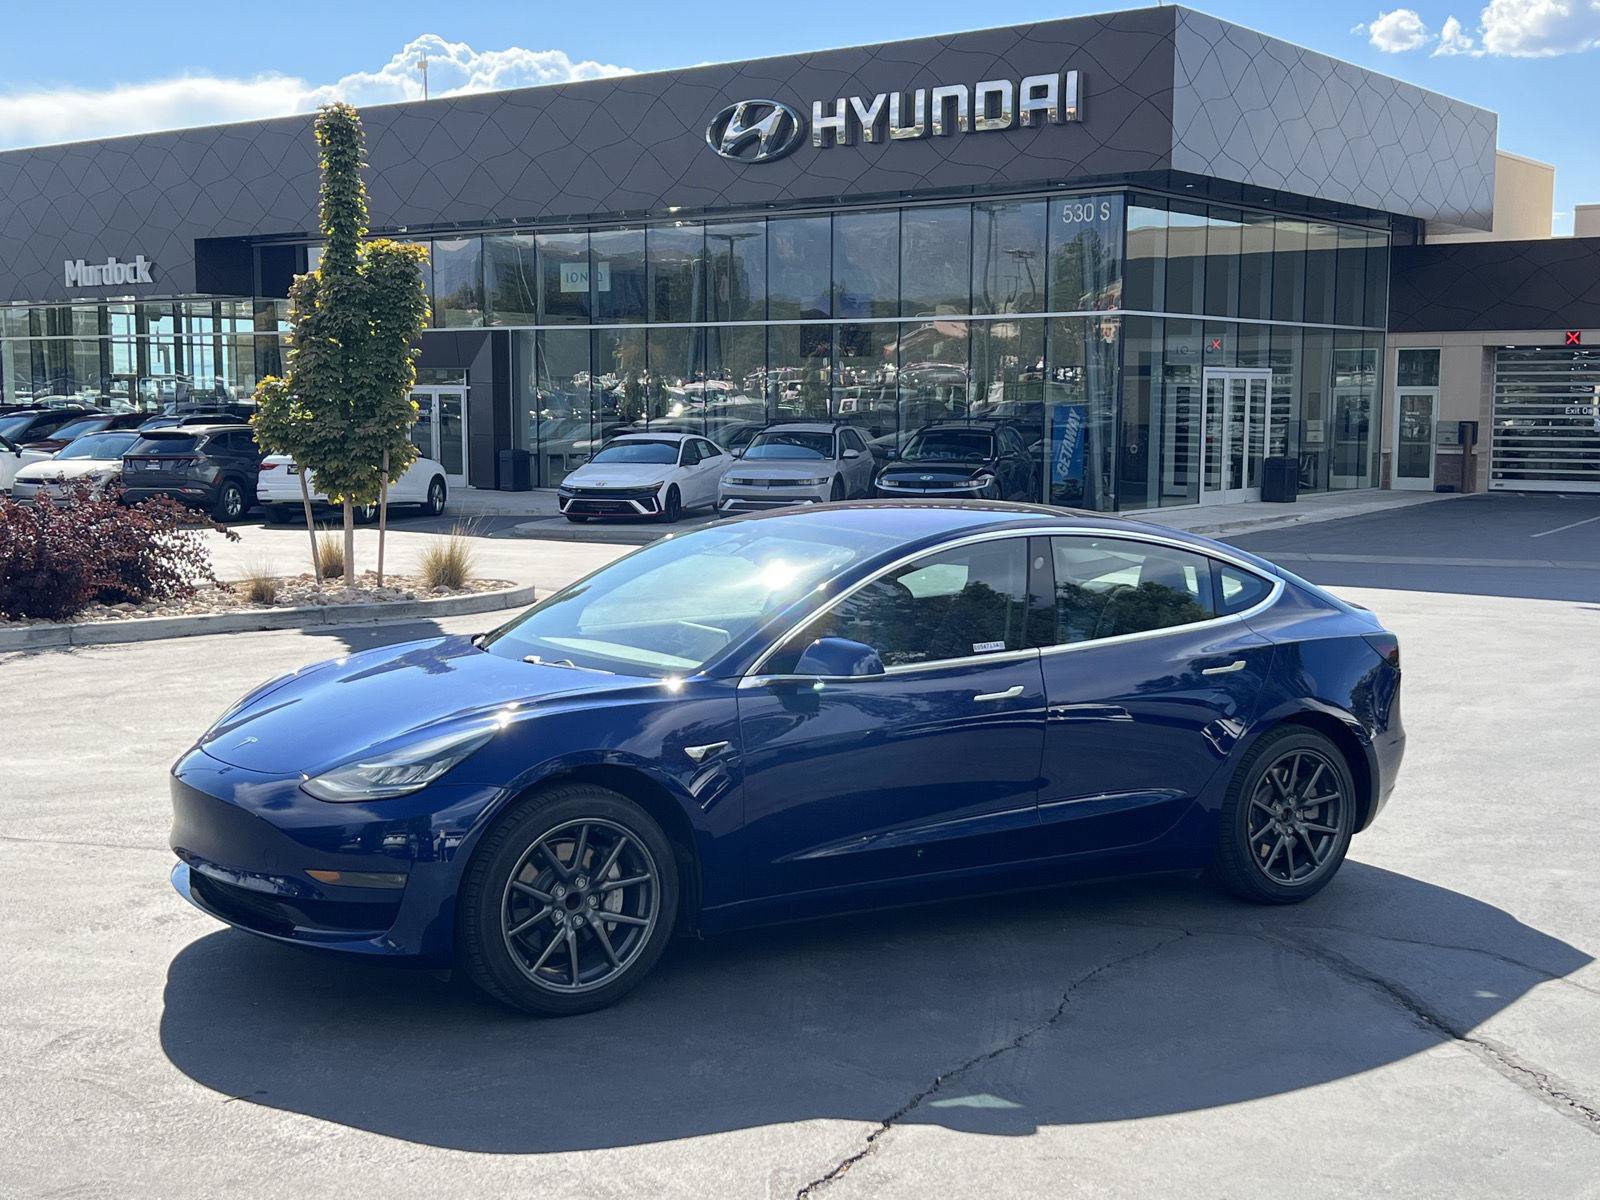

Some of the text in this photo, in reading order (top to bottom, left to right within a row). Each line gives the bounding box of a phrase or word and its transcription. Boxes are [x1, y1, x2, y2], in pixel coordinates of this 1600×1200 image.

[812, 70, 1083, 148] HYUNDAI
[1062, 202, 1111, 223] 530 S
[64, 254, 153, 288] Murdock
[1056, 407, 1081, 478] GETAWAY
